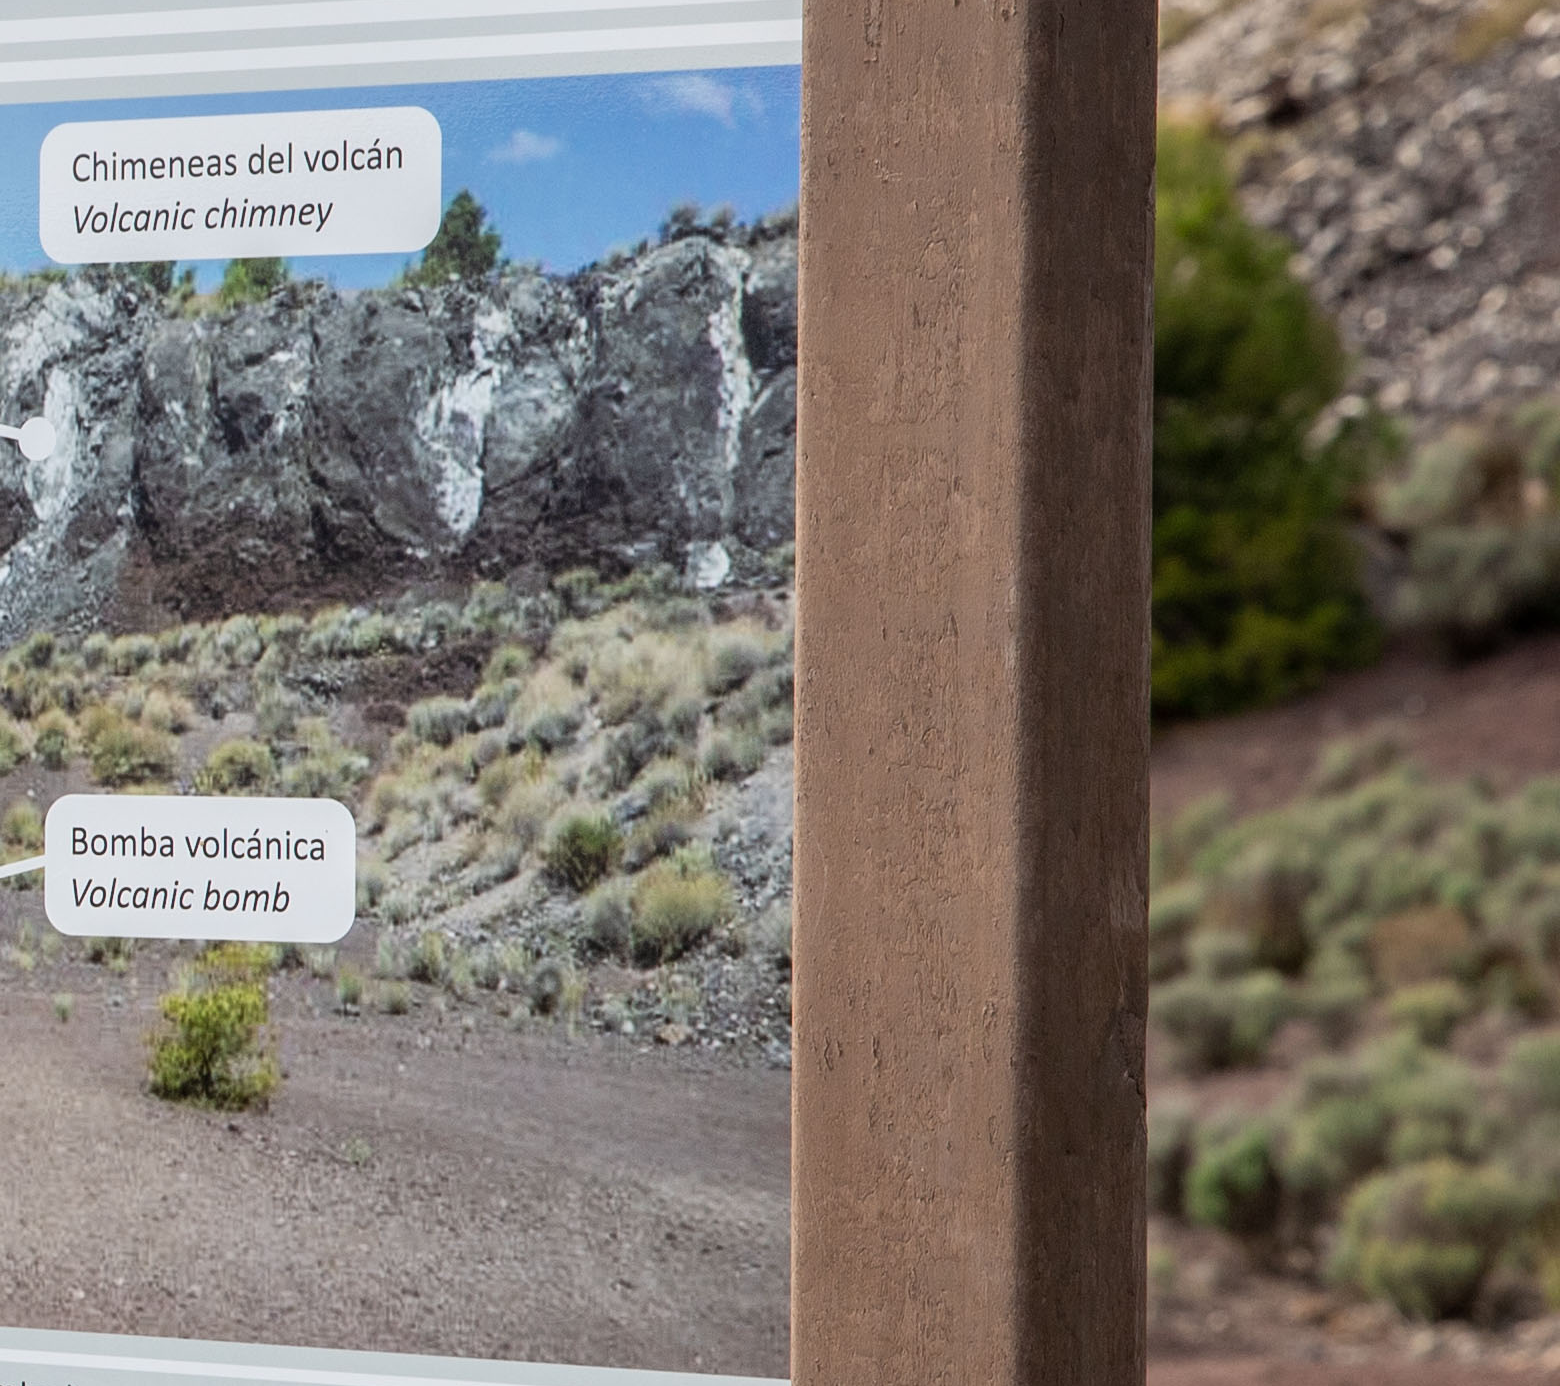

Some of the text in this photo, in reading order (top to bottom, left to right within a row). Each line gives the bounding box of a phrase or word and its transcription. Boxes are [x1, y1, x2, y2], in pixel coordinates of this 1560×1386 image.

[73, 138, 402, 182] Chimeneas del volcán
[74, 198, 333, 234] Volcanic chimney
[72, 826, 324, 860] Bomba volcánica
[73, 877, 289, 912] Volcanic bomb
